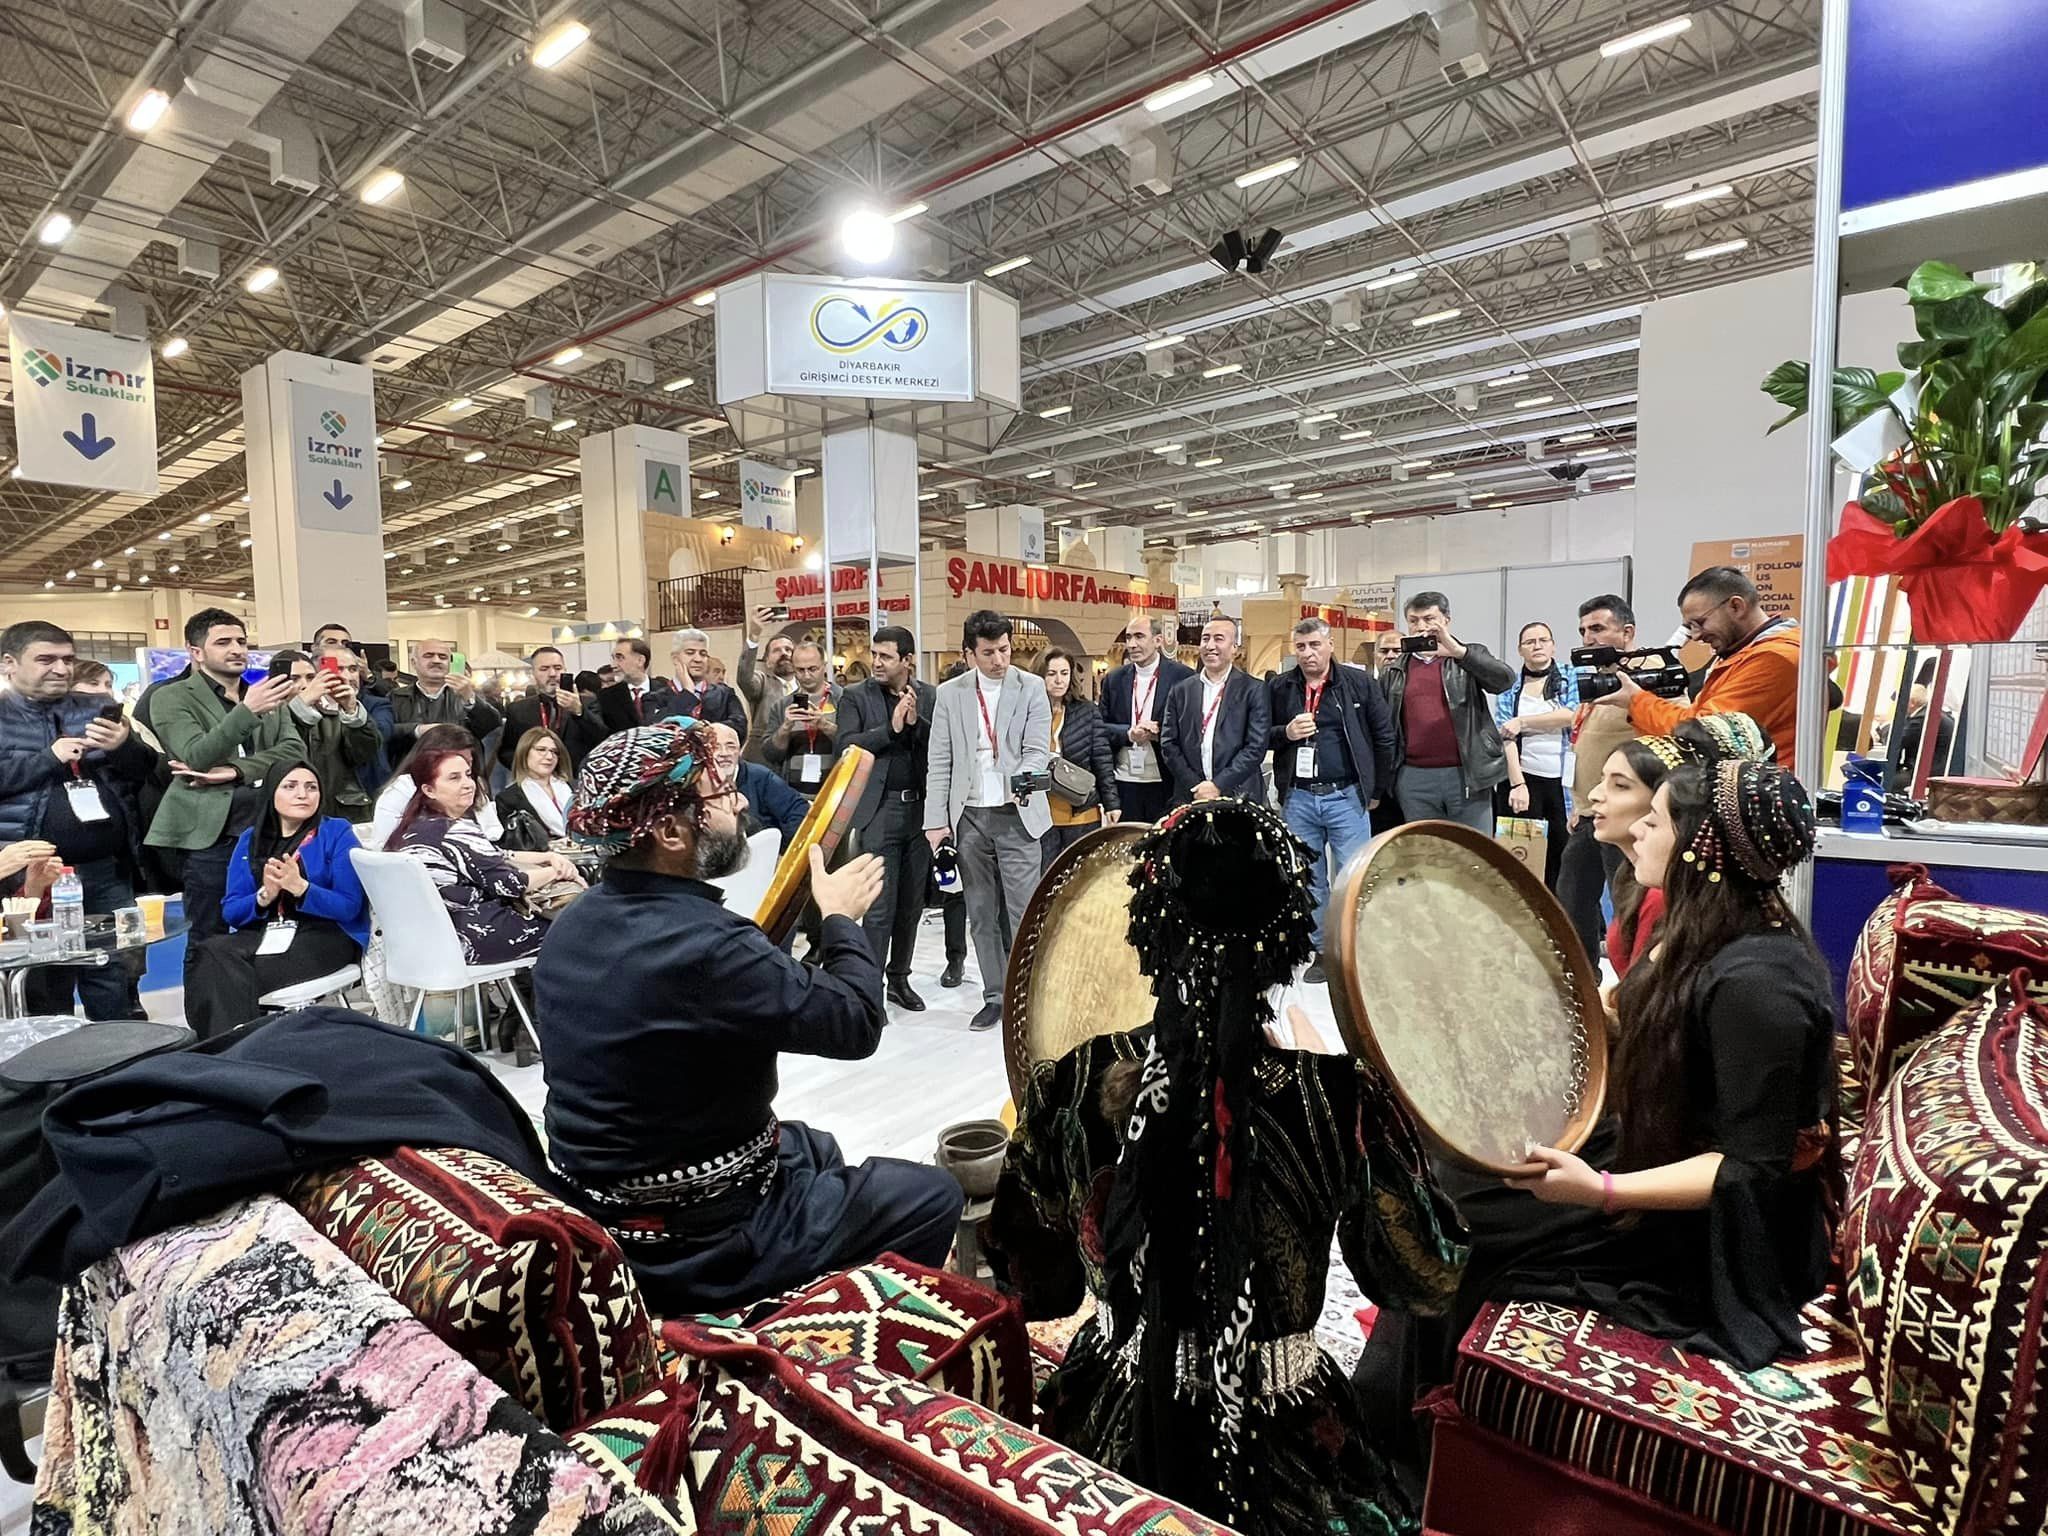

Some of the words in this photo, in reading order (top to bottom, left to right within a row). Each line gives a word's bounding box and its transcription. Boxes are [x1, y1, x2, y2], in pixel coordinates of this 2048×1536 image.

[66, 357, 146, 389] izmir
[800, 371, 849, 383] GİRİŞİMCİ
[851, 374, 892, 385] DESTEK
[895, 376, 940, 388] MERKEZİ
[66, 380, 146, 403] Sokakları
[308, 436, 362, 458] izmir
[653, 468, 676, 503] A
[1756, 561, 1803, 571] FOLLOW
[775, 567, 884, 604] ŞANLURF
[947, 557, 1099, 605] ŞANLIURFA
